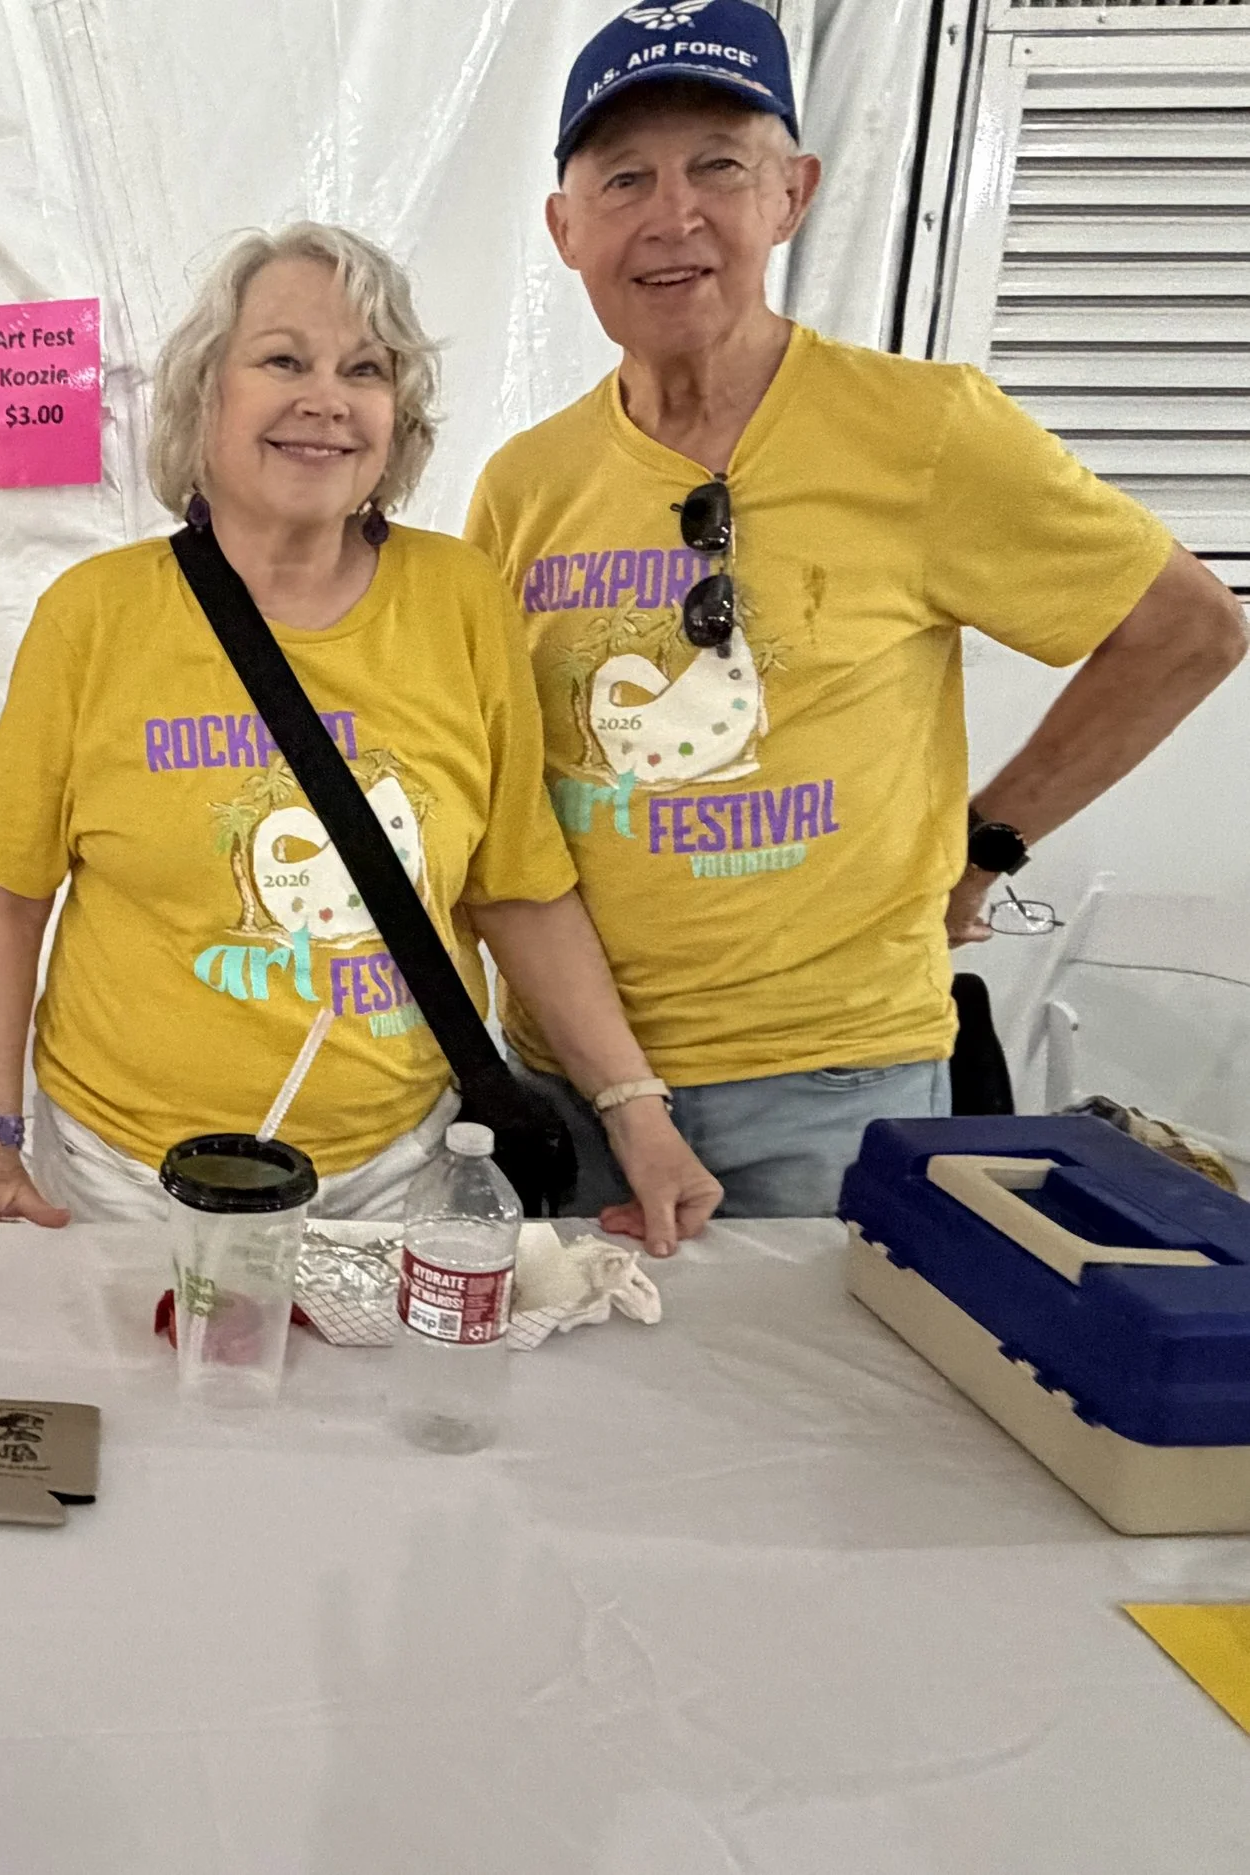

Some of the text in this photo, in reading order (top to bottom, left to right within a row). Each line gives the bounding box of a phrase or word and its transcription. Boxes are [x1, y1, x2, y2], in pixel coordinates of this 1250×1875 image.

[587, 68, 620, 101] U.S.
[627, 43, 667, 68] AIR
[32, 328, 75, 347] Fest
[0, 364, 69, 387] Koozie
[5, 404, 64, 428] $3.00
[597, 715, 642, 731] 2026
[649, 779, 839, 853] FESTIVAL
[263, 870, 310, 888] 2026
[194, 924, 320, 1001] art
[413, 1261, 467, 1290] HYDRATE
